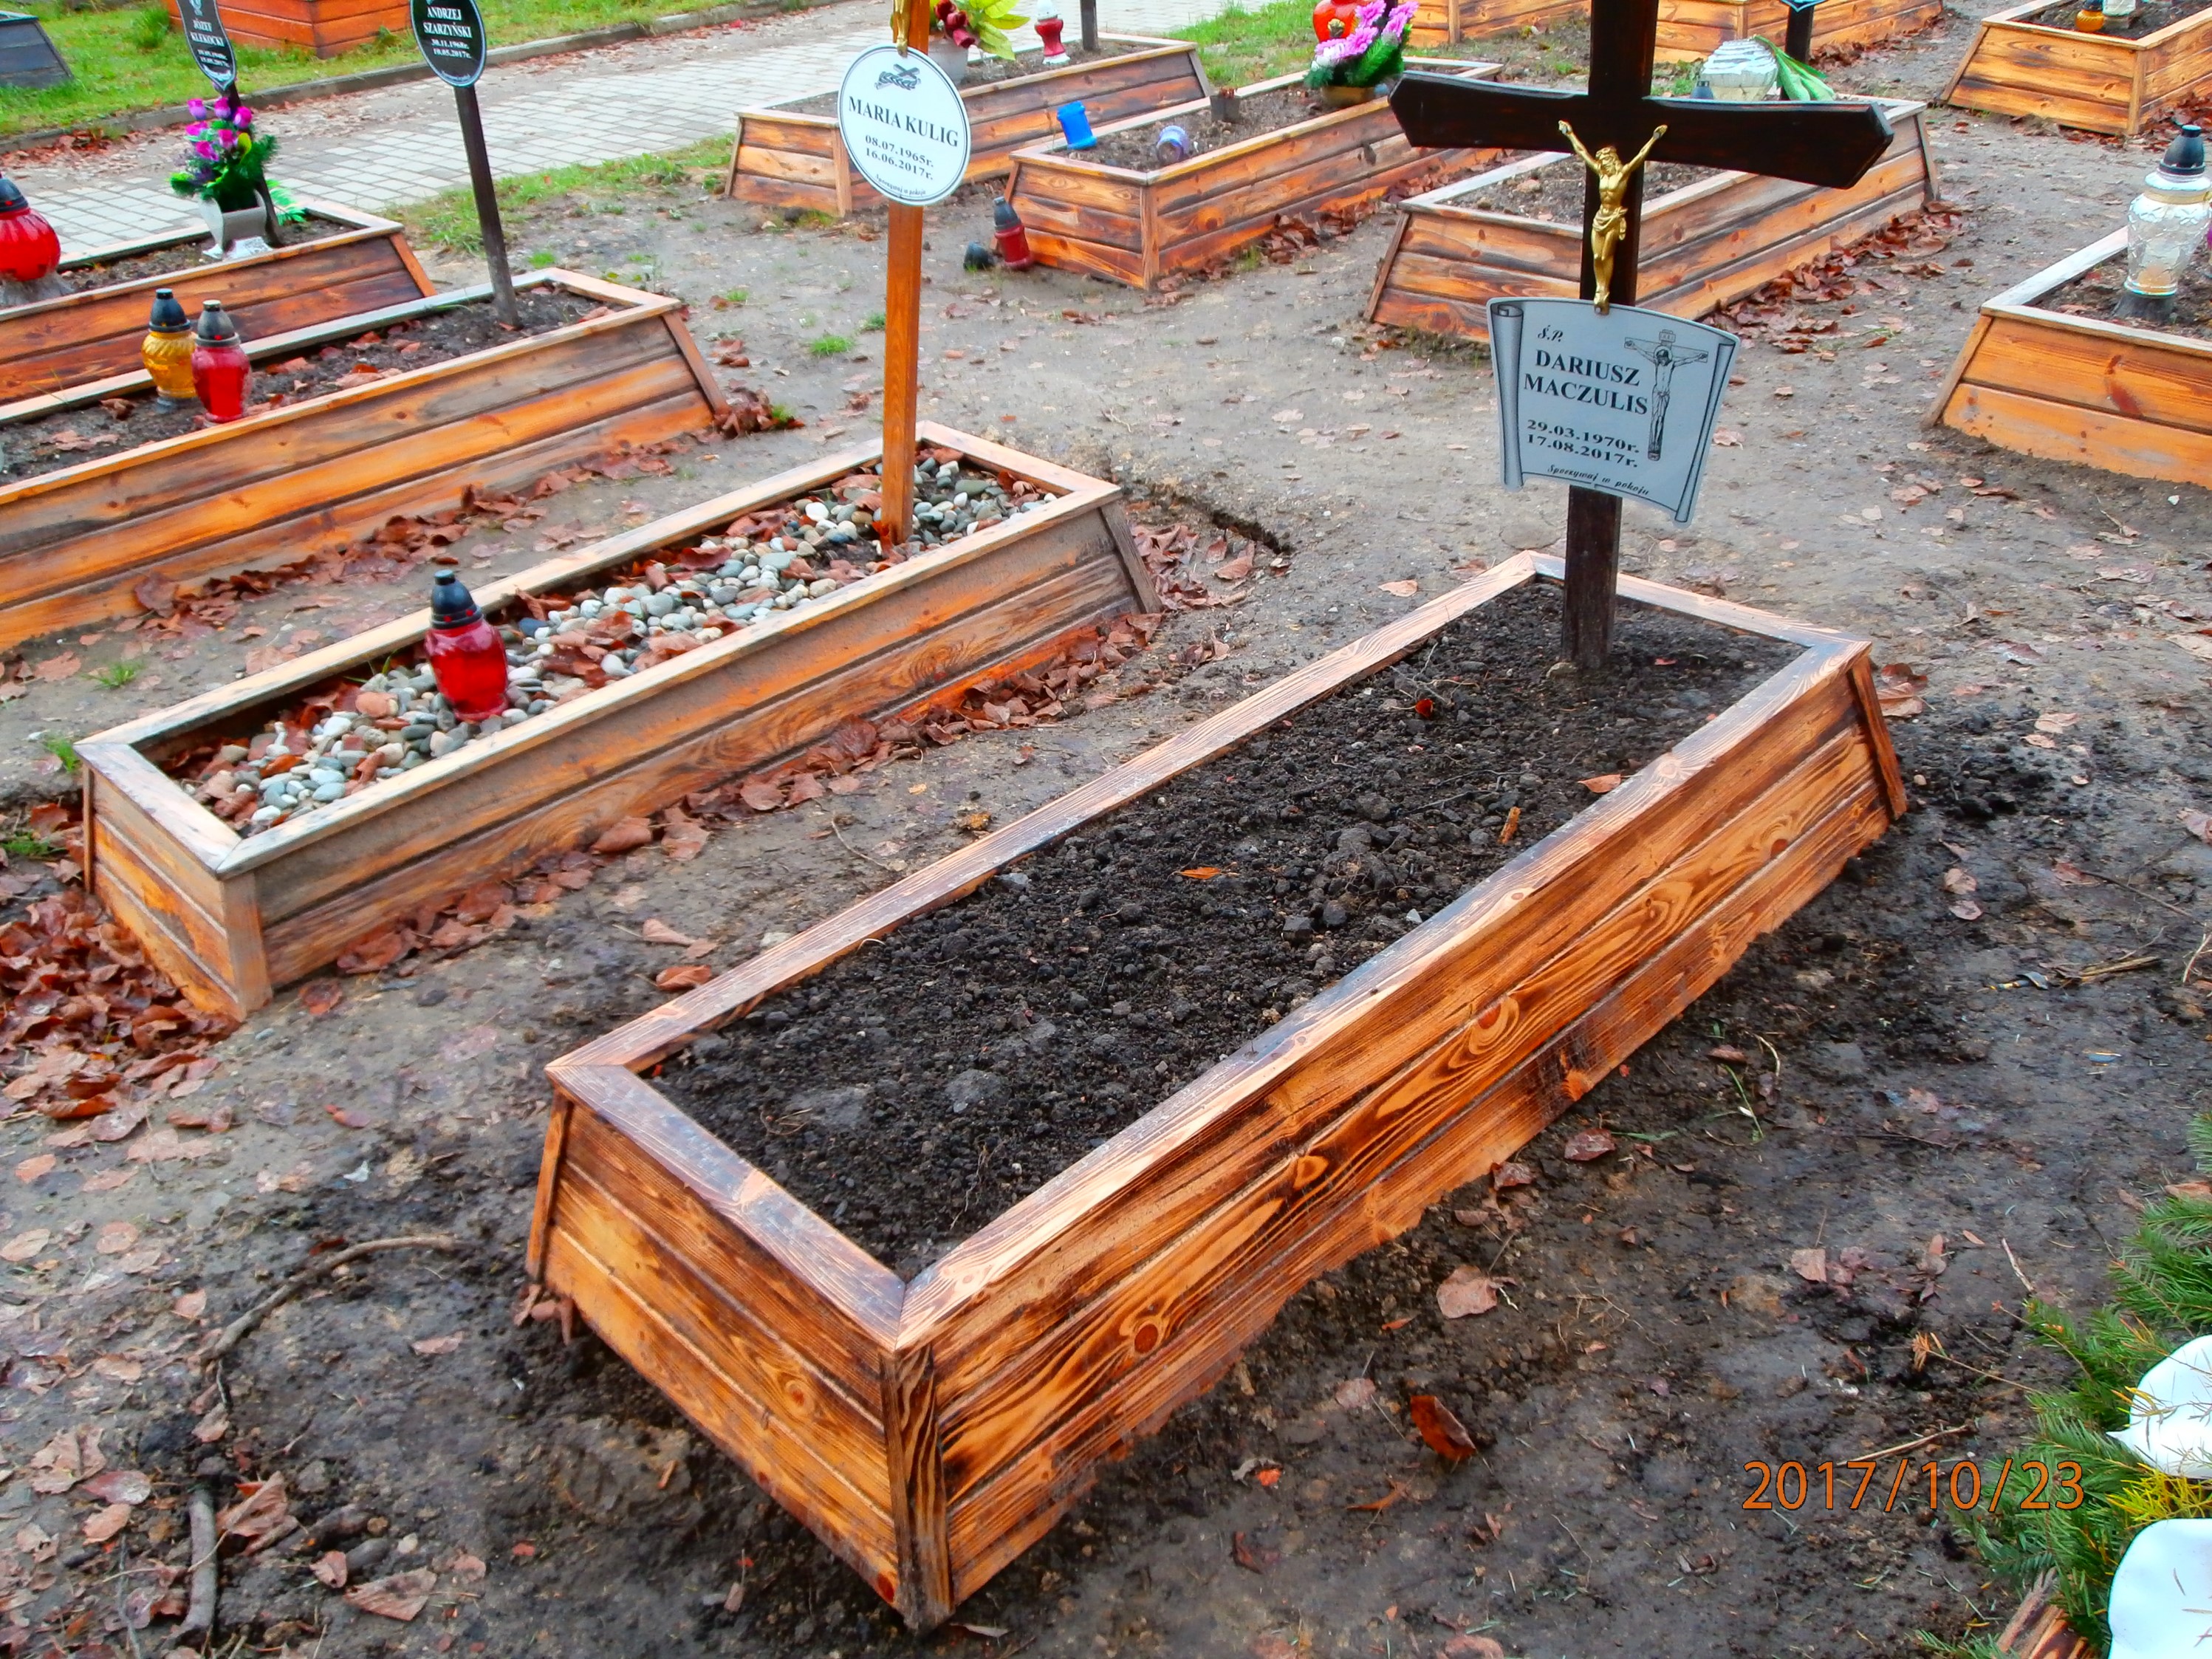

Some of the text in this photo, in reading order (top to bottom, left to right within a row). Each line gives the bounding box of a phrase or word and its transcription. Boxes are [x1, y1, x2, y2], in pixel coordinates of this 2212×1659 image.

[193, 17, 212, 32] JÓZEF
[423, 21, 473, 38] SZARZYŃSKI
[427, 7, 462, 21] ANDRZEJ
[849, 96, 959, 147] MARIA KULIG
[866, 134, 934, 167] 08.07.1965r.
[866, 148, 934, 179] 16.06.2017r.
[1537, 325, 1563, 343] Ś.P.
[1535, 349, 1640, 386] DARIUSZ
[1524, 373, 1648, 415] MACZULIS
[1527, 420, 1640, 454] 29.03.1970r.
[1527, 434, 1638, 468] 17.08.2017r.
[1615, 482, 1650, 496] pokoju
